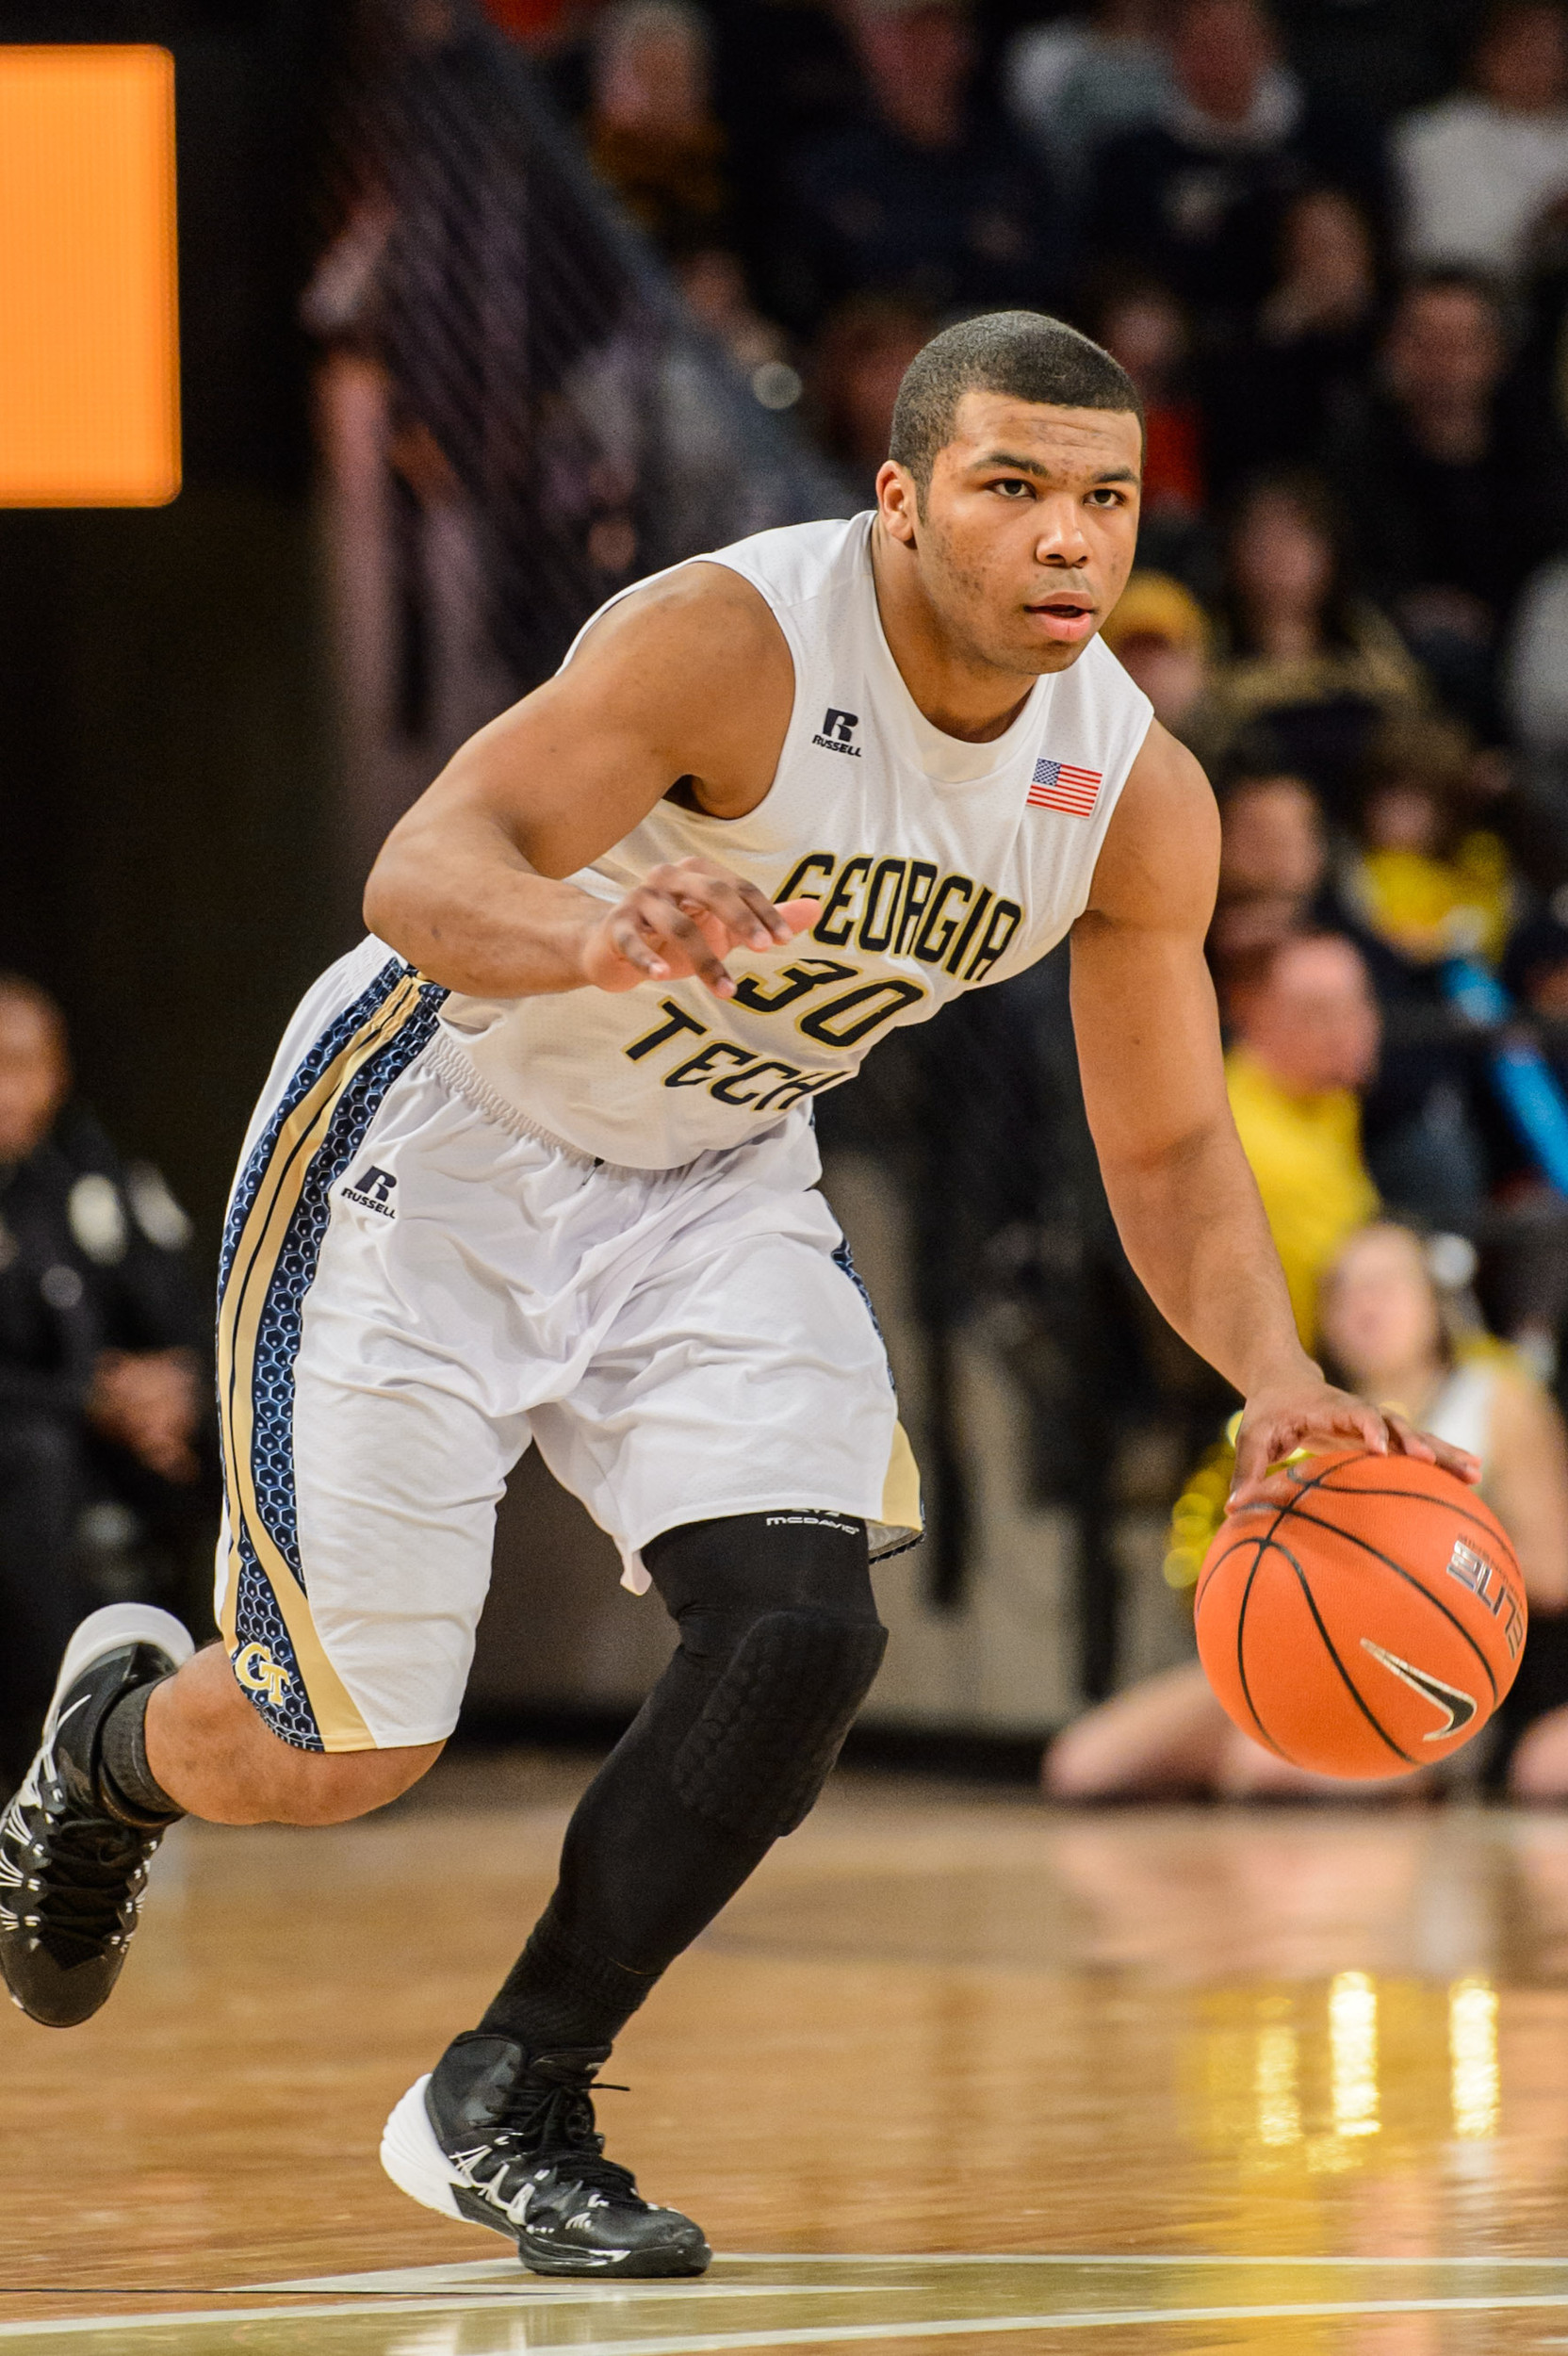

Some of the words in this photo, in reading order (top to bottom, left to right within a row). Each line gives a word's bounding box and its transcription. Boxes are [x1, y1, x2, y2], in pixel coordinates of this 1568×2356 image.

[811, 734, 862, 758] RUSSELL
[773, 851, 1024, 982] GEORGIA
[729, 957, 928, 1050] 30
[621, 995, 850, 1111] TECH
[340, 1187, 397, 1219] RUSSELL
[235, 1642, 291, 1707] GT
